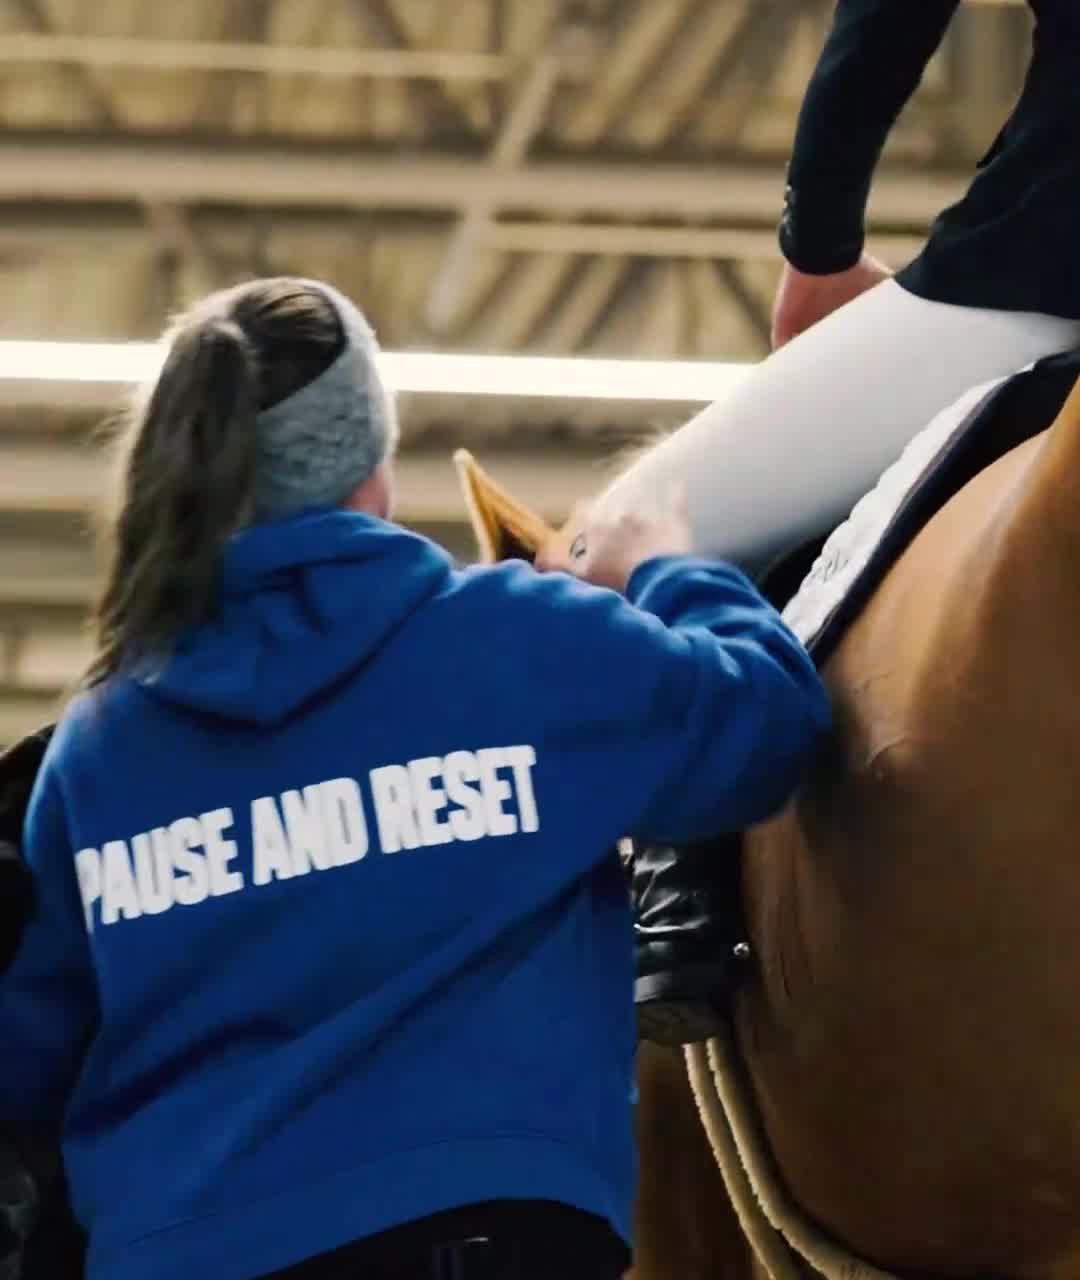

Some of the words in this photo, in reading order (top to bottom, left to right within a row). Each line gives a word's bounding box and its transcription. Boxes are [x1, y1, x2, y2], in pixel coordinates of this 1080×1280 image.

[75, 807, 243, 931] PAUSE
[251, 777, 369, 886] AND
[369, 744, 539, 854] RESET
